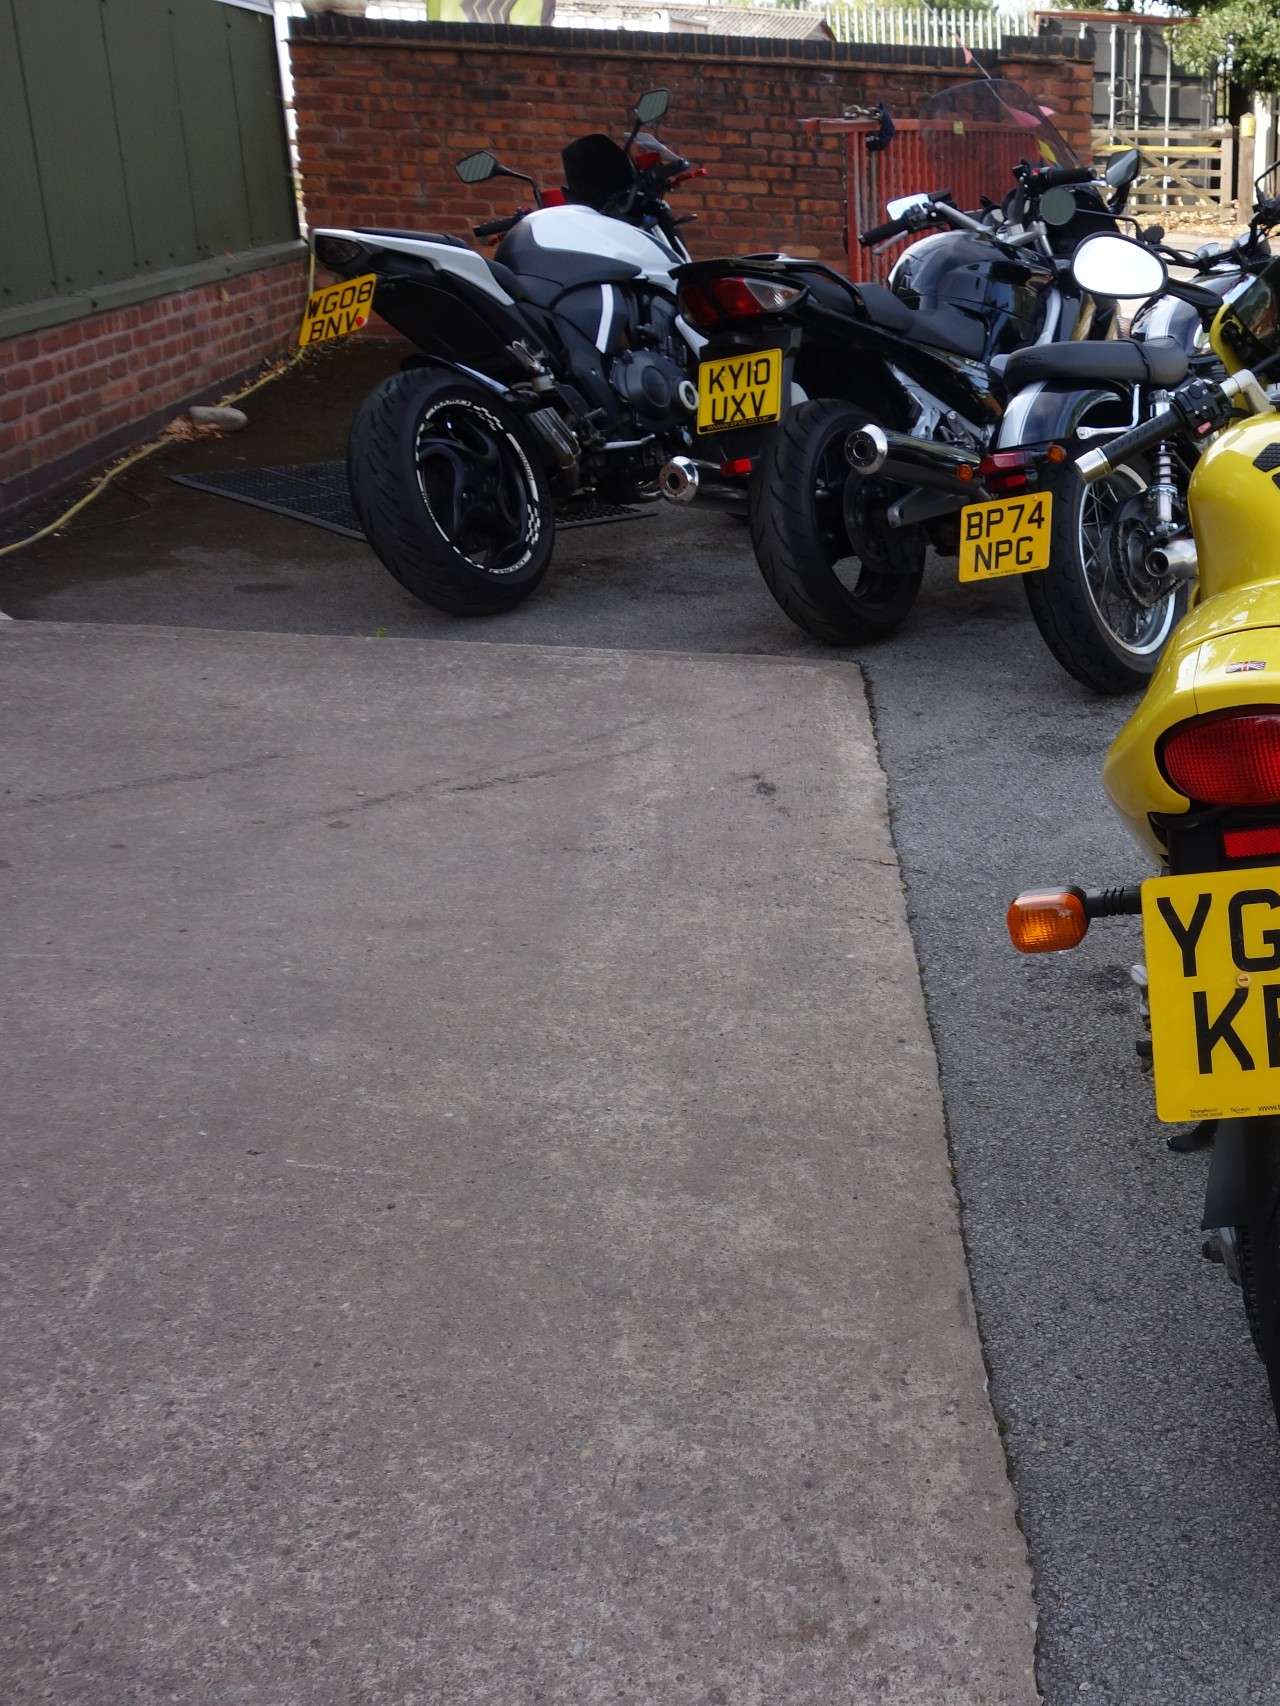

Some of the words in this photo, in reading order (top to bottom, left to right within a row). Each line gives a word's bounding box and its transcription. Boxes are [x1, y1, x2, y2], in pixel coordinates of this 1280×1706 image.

[308, 281, 374, 320] WG08
[309, 308, 361, 343] BNV
[709, 358, 770, 394] KY10
[712, 389, 765, 424] UXV
[966, 501, 1044, 541] BP74
[974, 536, 1033, 573] NPG
